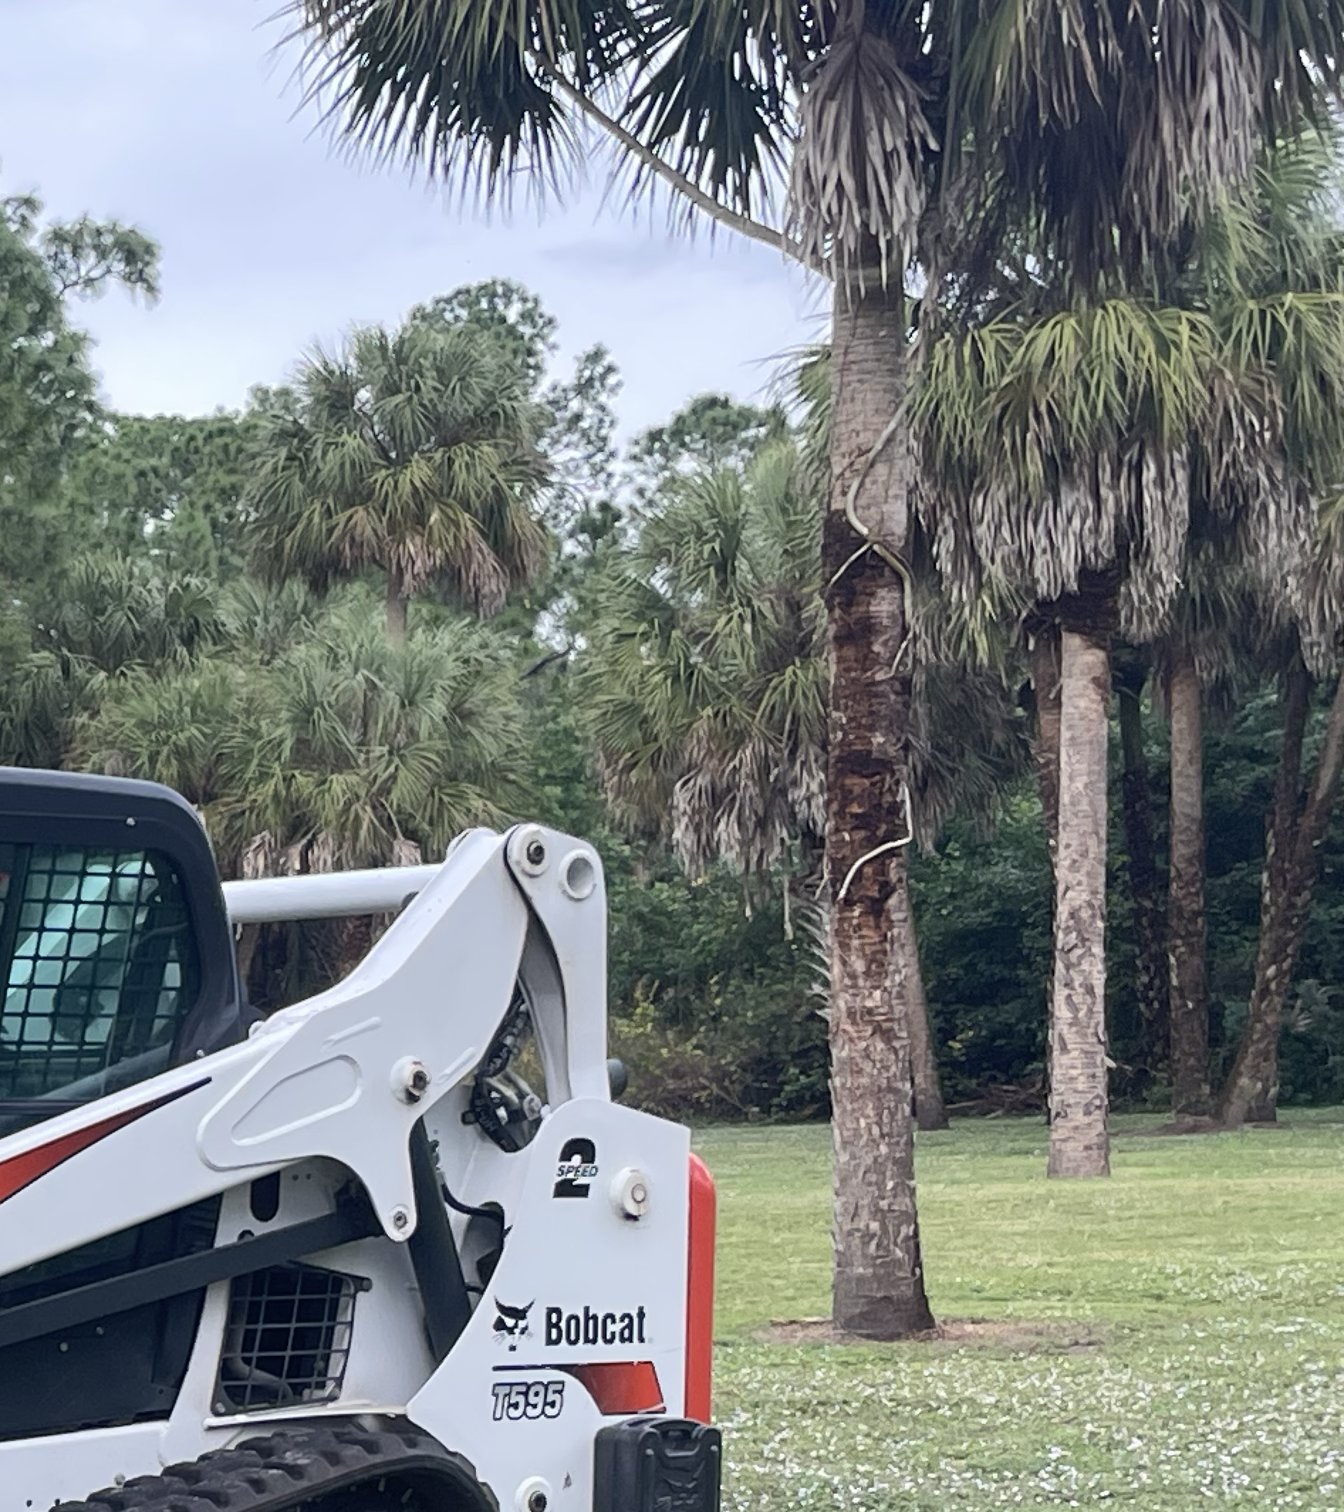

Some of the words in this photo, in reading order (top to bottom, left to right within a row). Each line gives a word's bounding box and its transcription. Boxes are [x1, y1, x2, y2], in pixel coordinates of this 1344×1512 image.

[553, 1137, 596, 1199] 2
[556, 1164, 599, 1178] SPEED
[544, 1305, 647, 1347] Bobcat
[491, 1380, 565, 1421] T595
